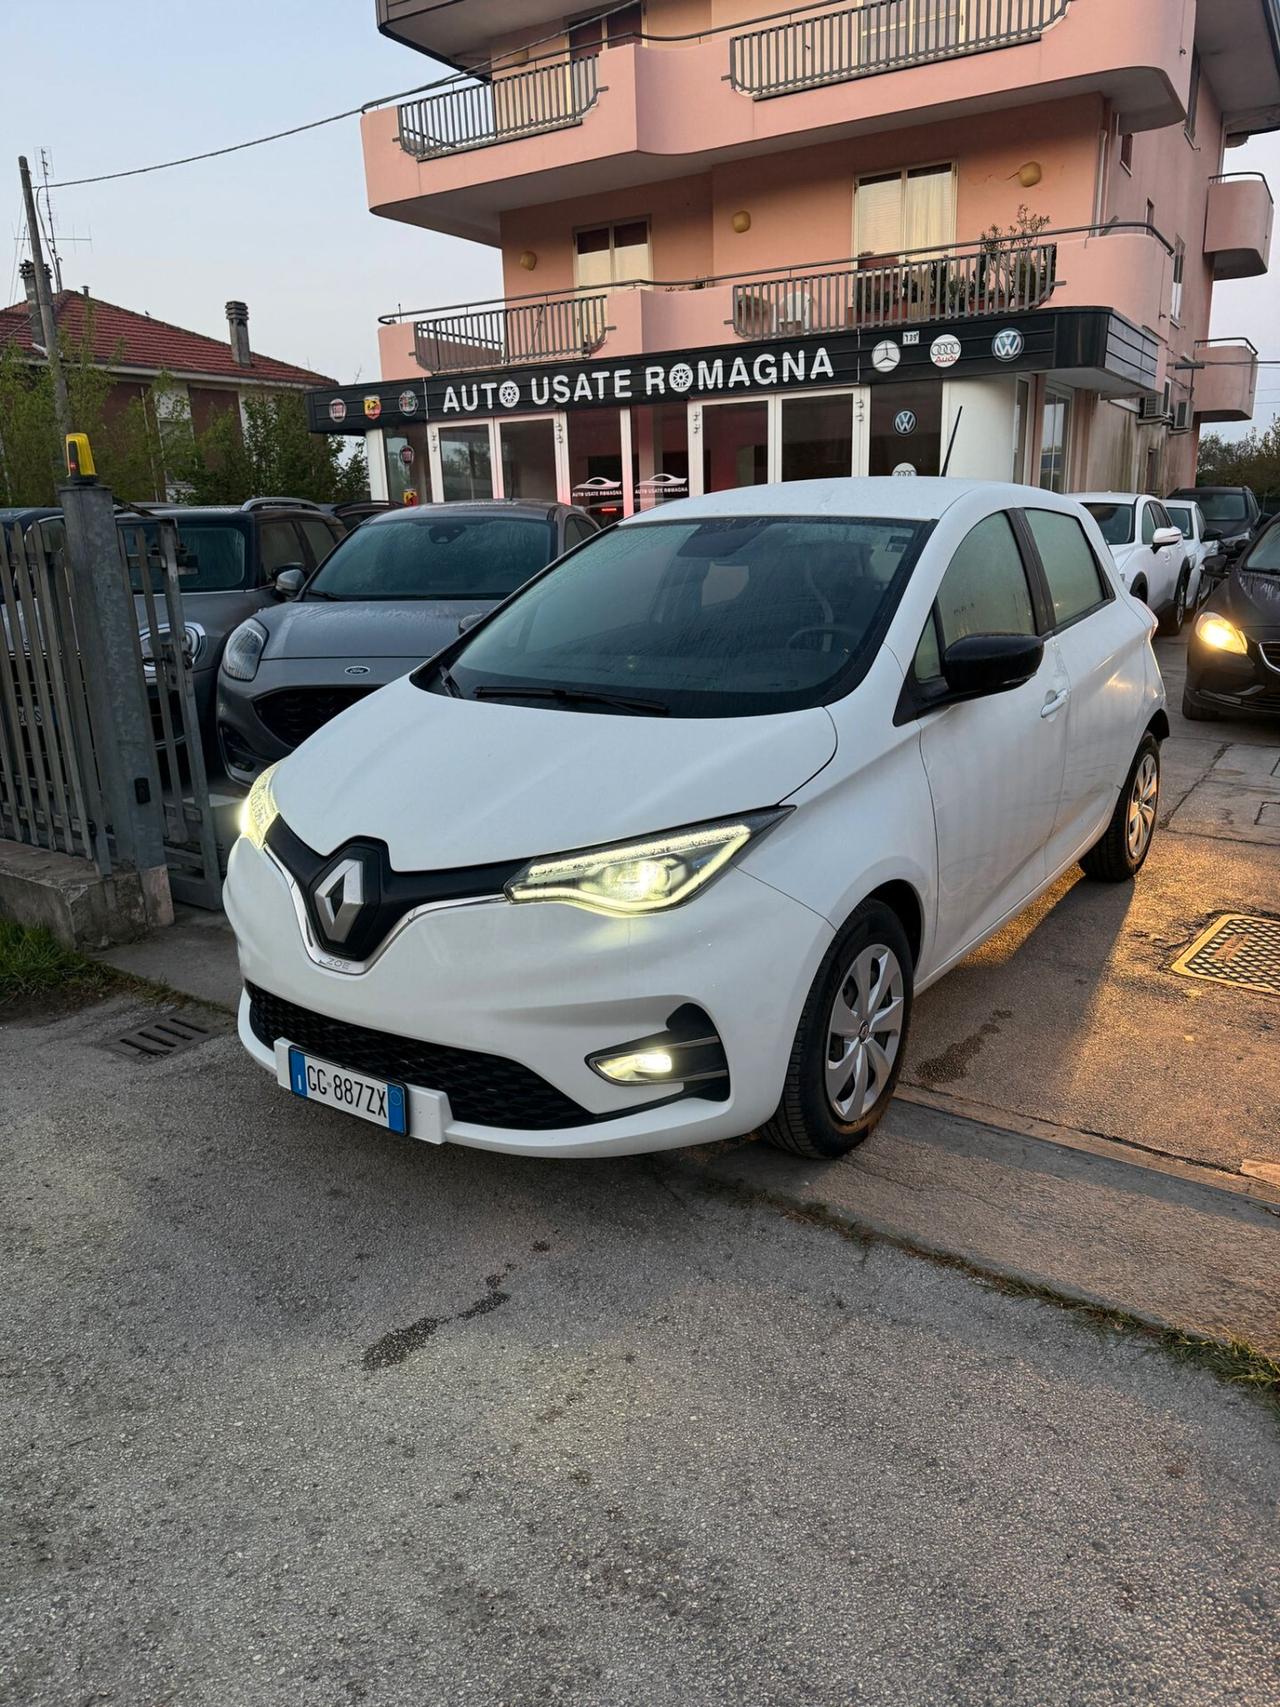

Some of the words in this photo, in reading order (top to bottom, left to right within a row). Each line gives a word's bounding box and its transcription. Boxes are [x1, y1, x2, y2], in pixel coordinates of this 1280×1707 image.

[443, 381, 520, 413] AUTO
[532, 369, 632, 405] USATE
[645, 347, 833, 396] ROMAGNA
[326, 957, 351, 970] ZOE
